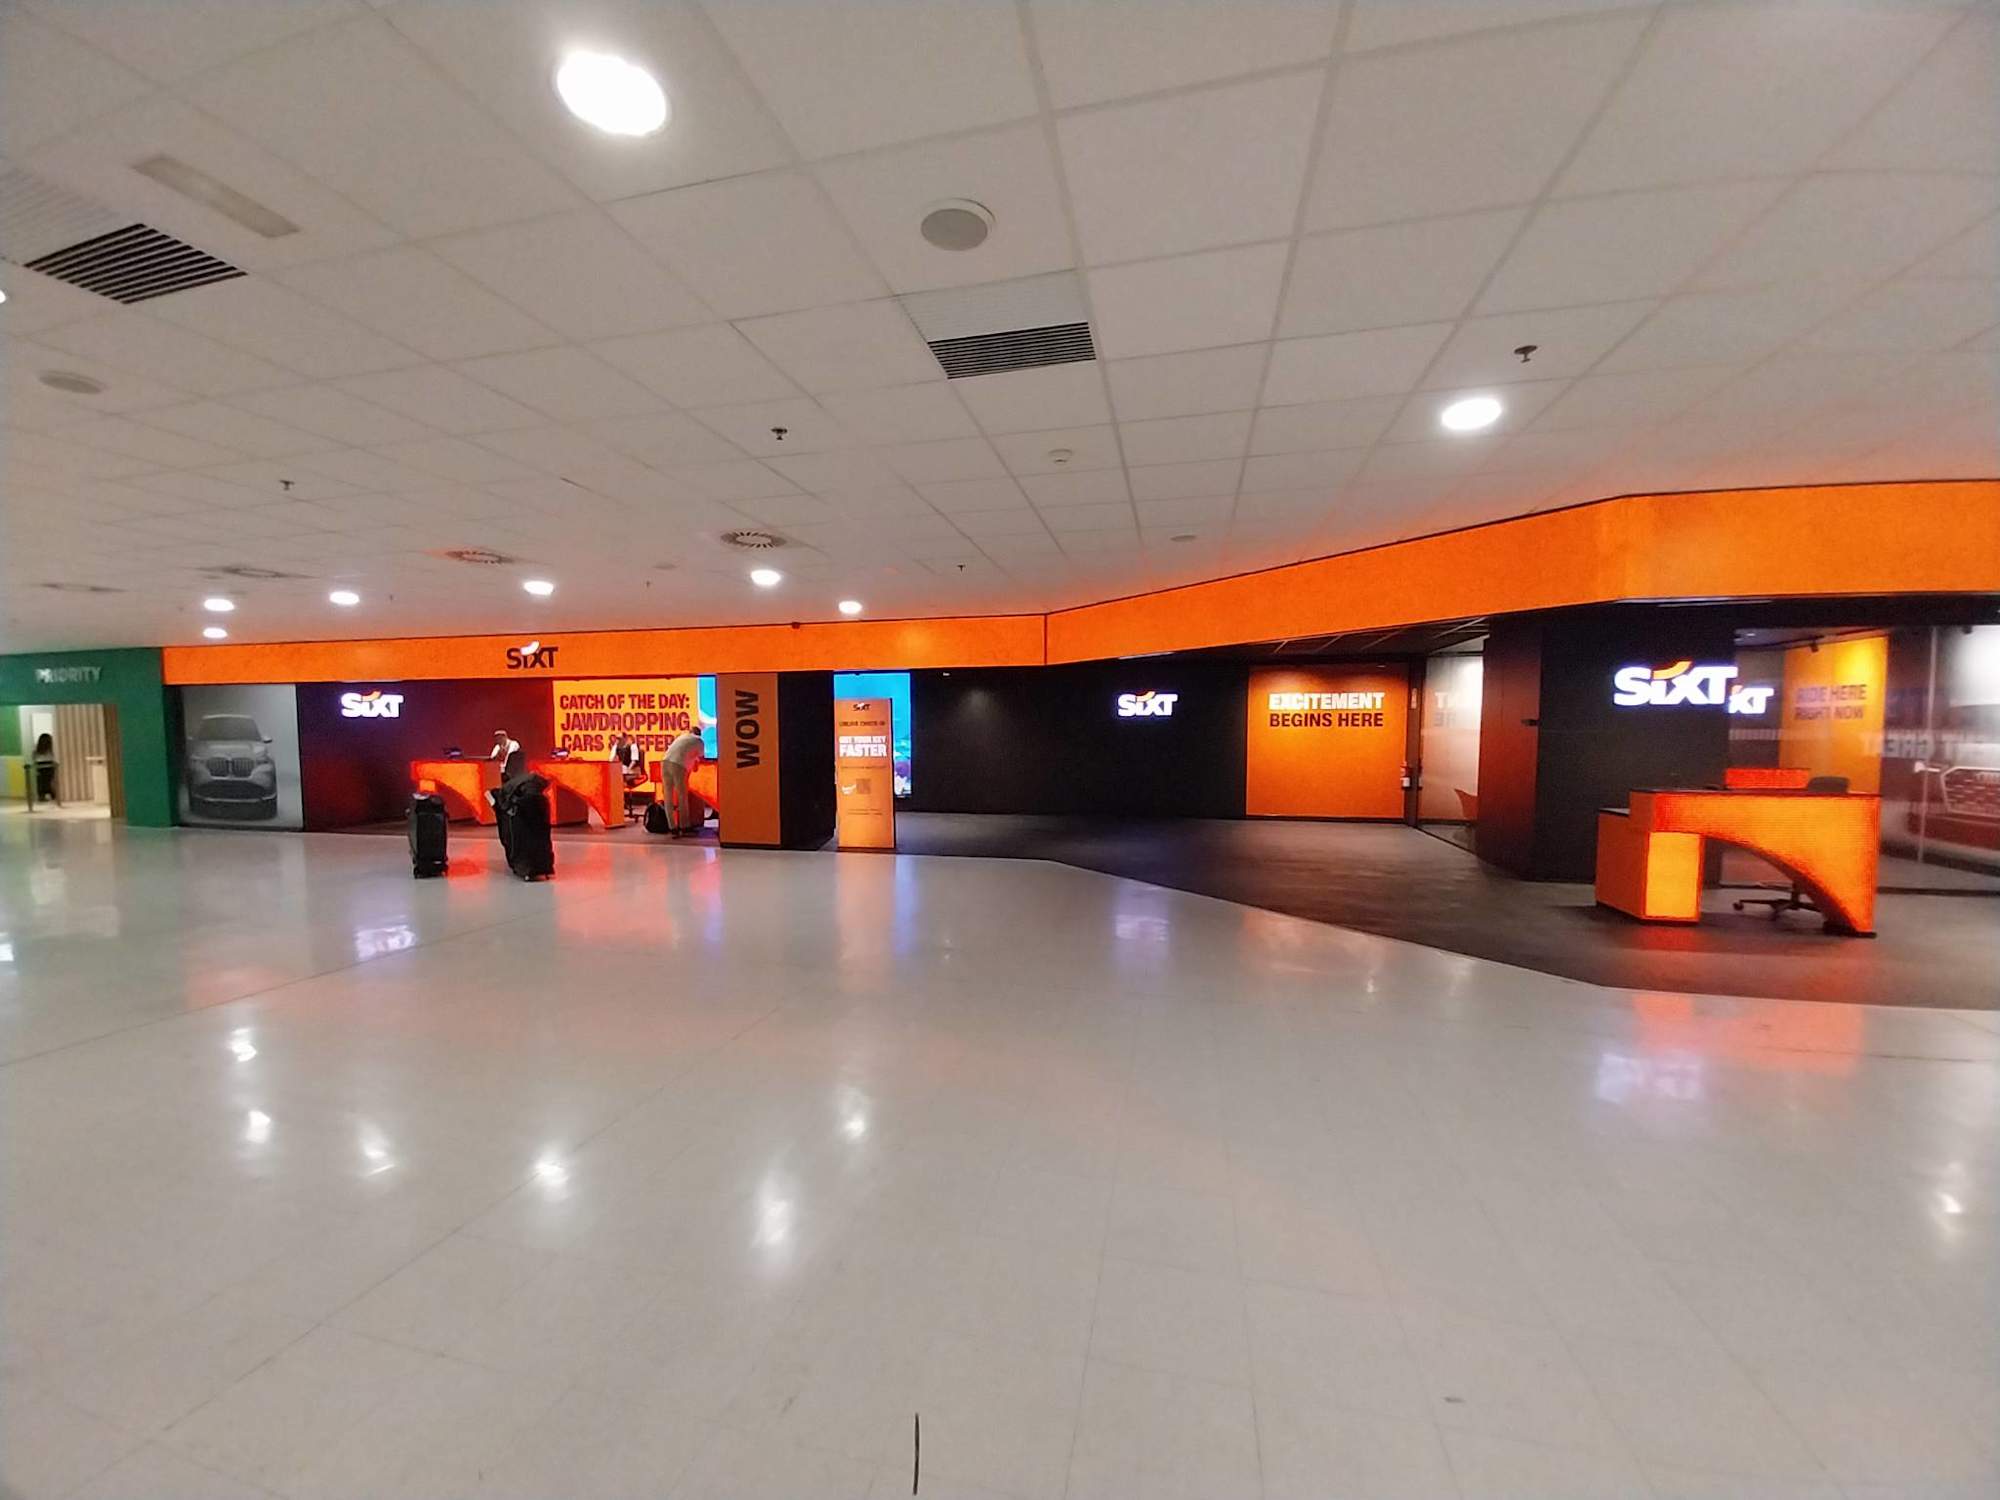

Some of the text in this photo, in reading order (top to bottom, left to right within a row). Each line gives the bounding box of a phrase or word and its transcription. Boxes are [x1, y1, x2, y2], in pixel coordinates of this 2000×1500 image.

[34, 666, 101, 684] PRIORITY
[560, 693, 690, 709] CATCH OF THE DAY:
[1269, 692, 1385, 710] EXCITEMENT
[1829, 684, 1867, 701] HERE
[1270, 713, 1384, 727] BEGINS HERE
[1794, 705, 1864, 720] RIGHT NOW
[561, 712, 690, 731] JAWDROPPING
[735, 689, 760, 768] WOW
[561, 734, 605, 751] CARS
[839, 744, 888, 757] FASTER
